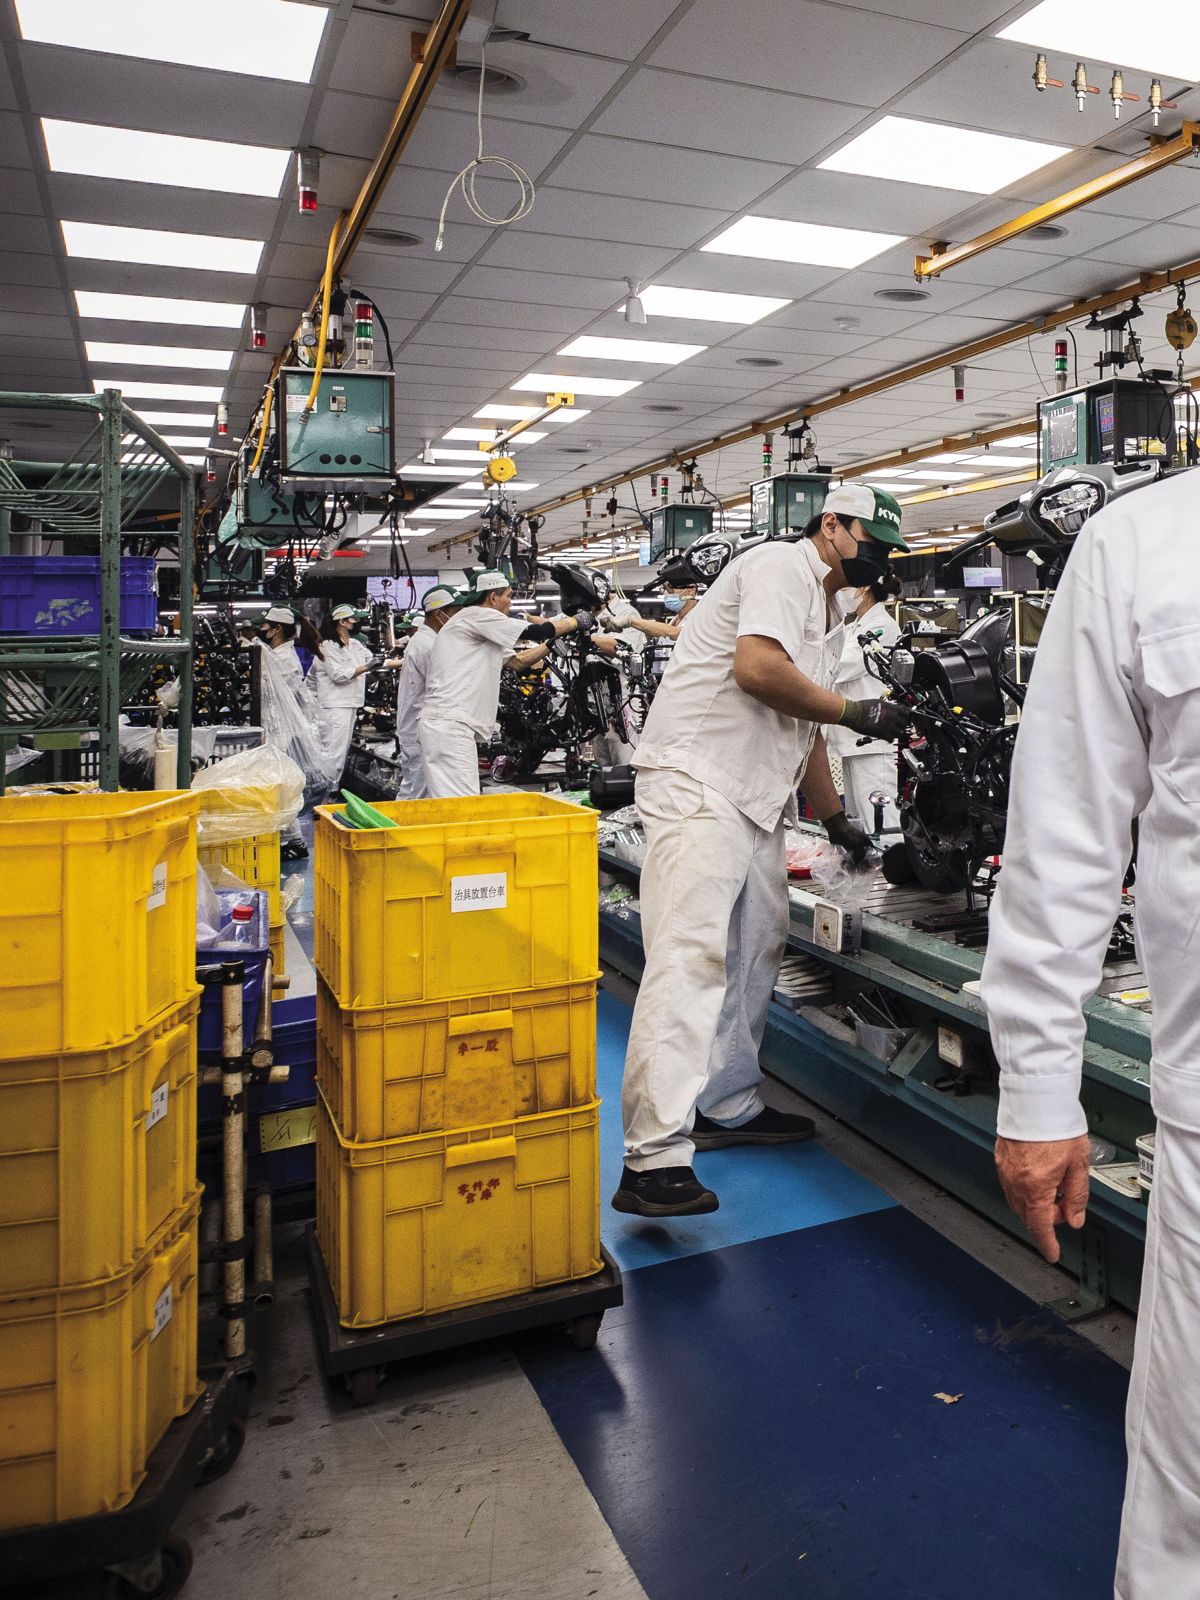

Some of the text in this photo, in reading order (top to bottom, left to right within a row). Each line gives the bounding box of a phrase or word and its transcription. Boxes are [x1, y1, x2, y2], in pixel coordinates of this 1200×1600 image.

[878, 507, 901, 525] KYM
[454, 884, 505, 901] 治具放置台車
